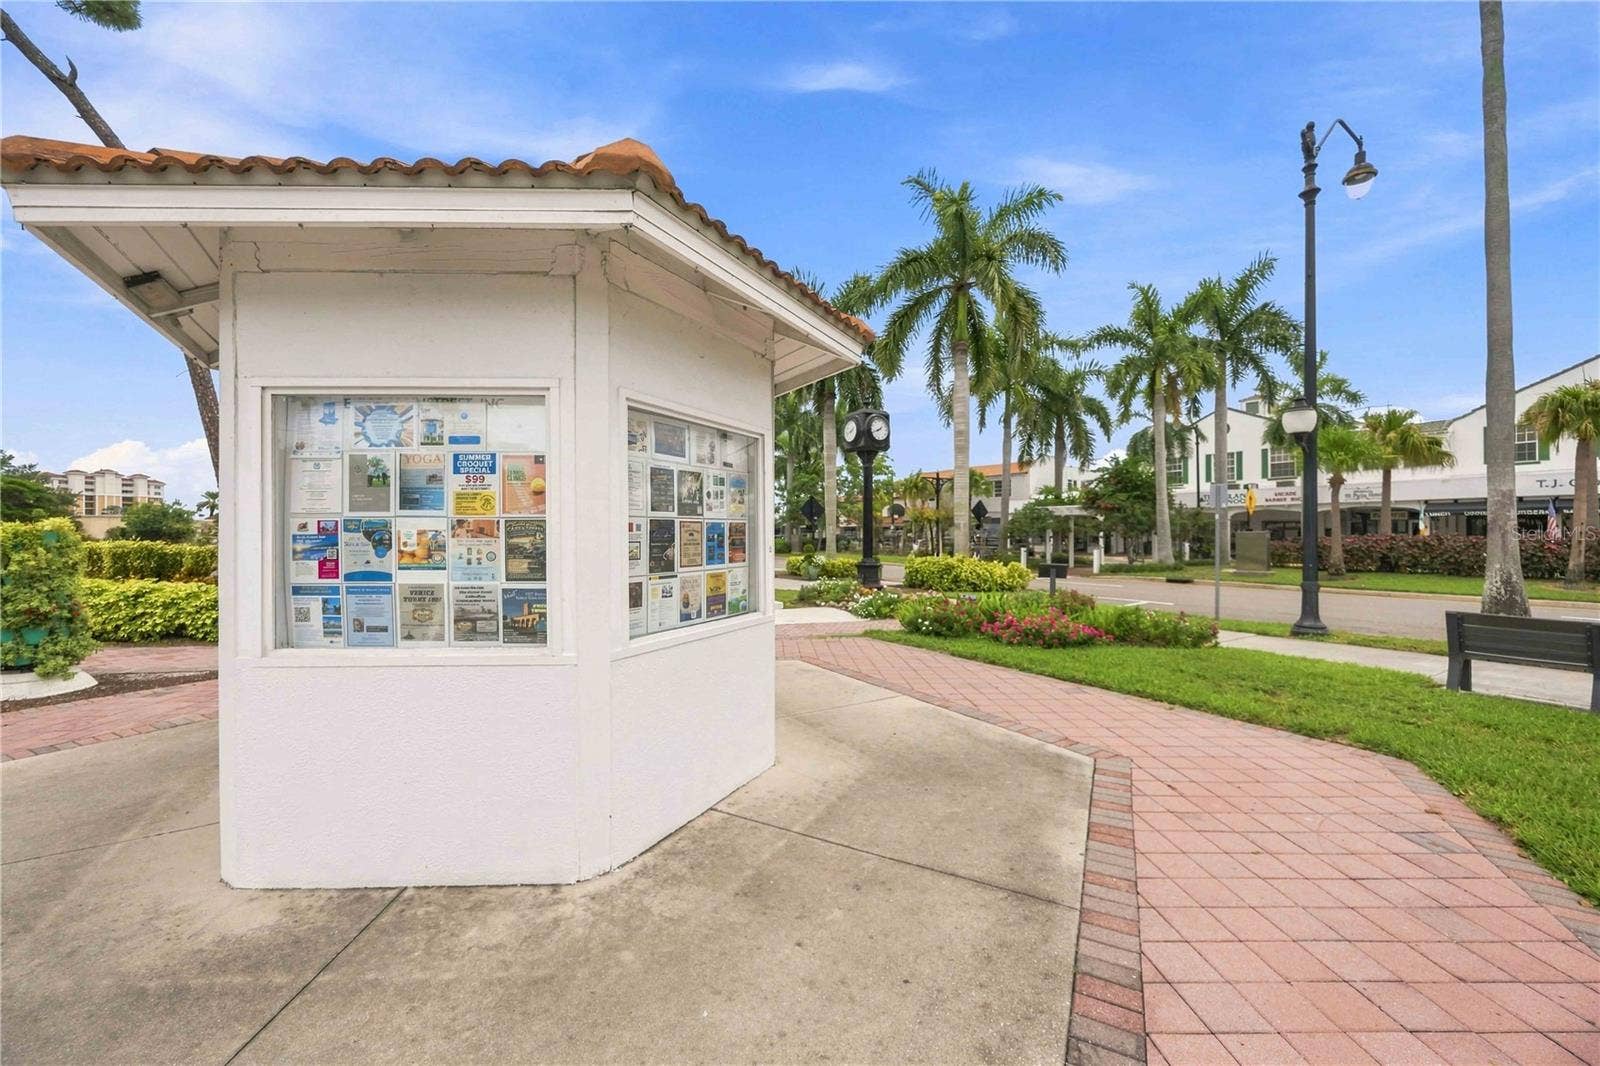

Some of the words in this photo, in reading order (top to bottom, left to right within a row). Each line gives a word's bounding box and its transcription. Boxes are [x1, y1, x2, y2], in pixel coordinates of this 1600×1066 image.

[403, 453, 443, 465] YOGA
[465, 474, 486, 484] $99
[1536, 478, 1564, 489] T.J.
